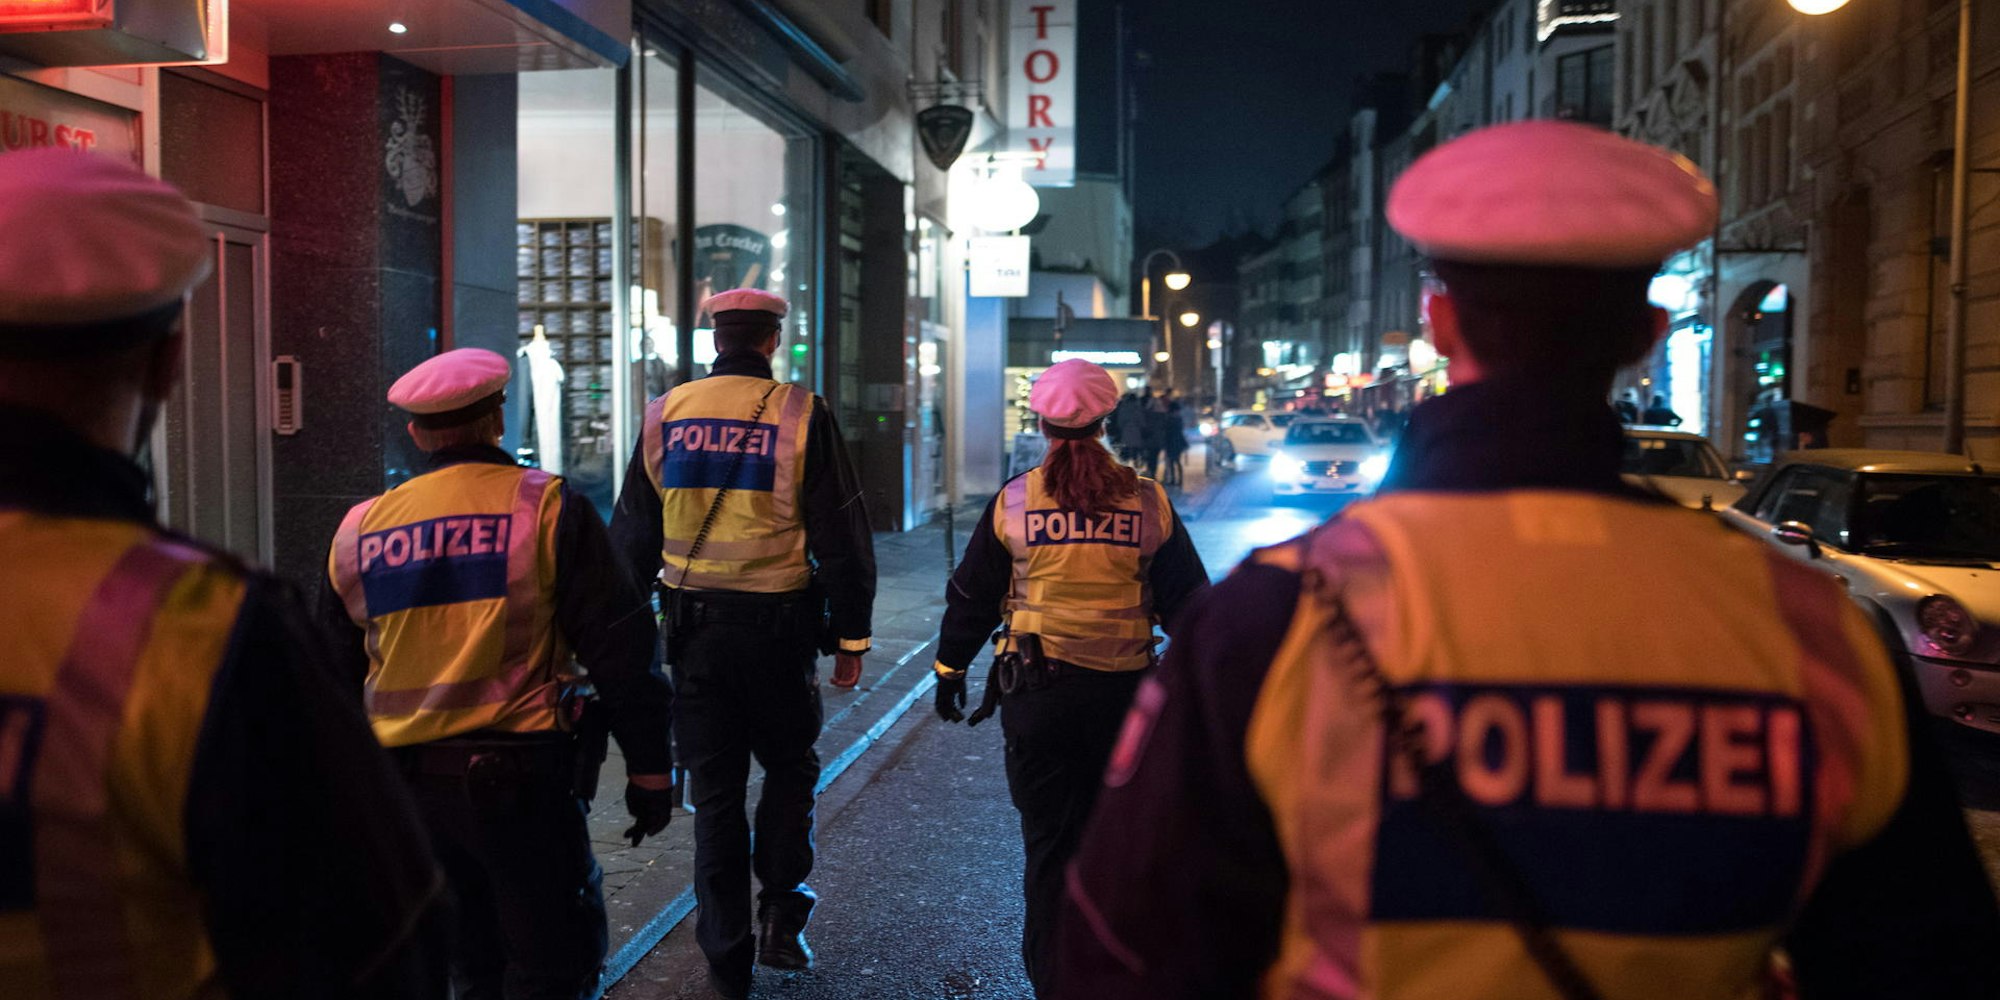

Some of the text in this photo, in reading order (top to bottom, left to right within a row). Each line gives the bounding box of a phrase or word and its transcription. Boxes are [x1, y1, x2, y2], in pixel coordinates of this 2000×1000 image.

[1023, 5, 1060, 171] TORY
[667, 425, 770, 456] POLIZEI
[361, 518, 509, 573] POLIZEI
[1027, 511, 1140, 543] POLIZEI
[1388, 693, 1800, 815] POLIZEI
